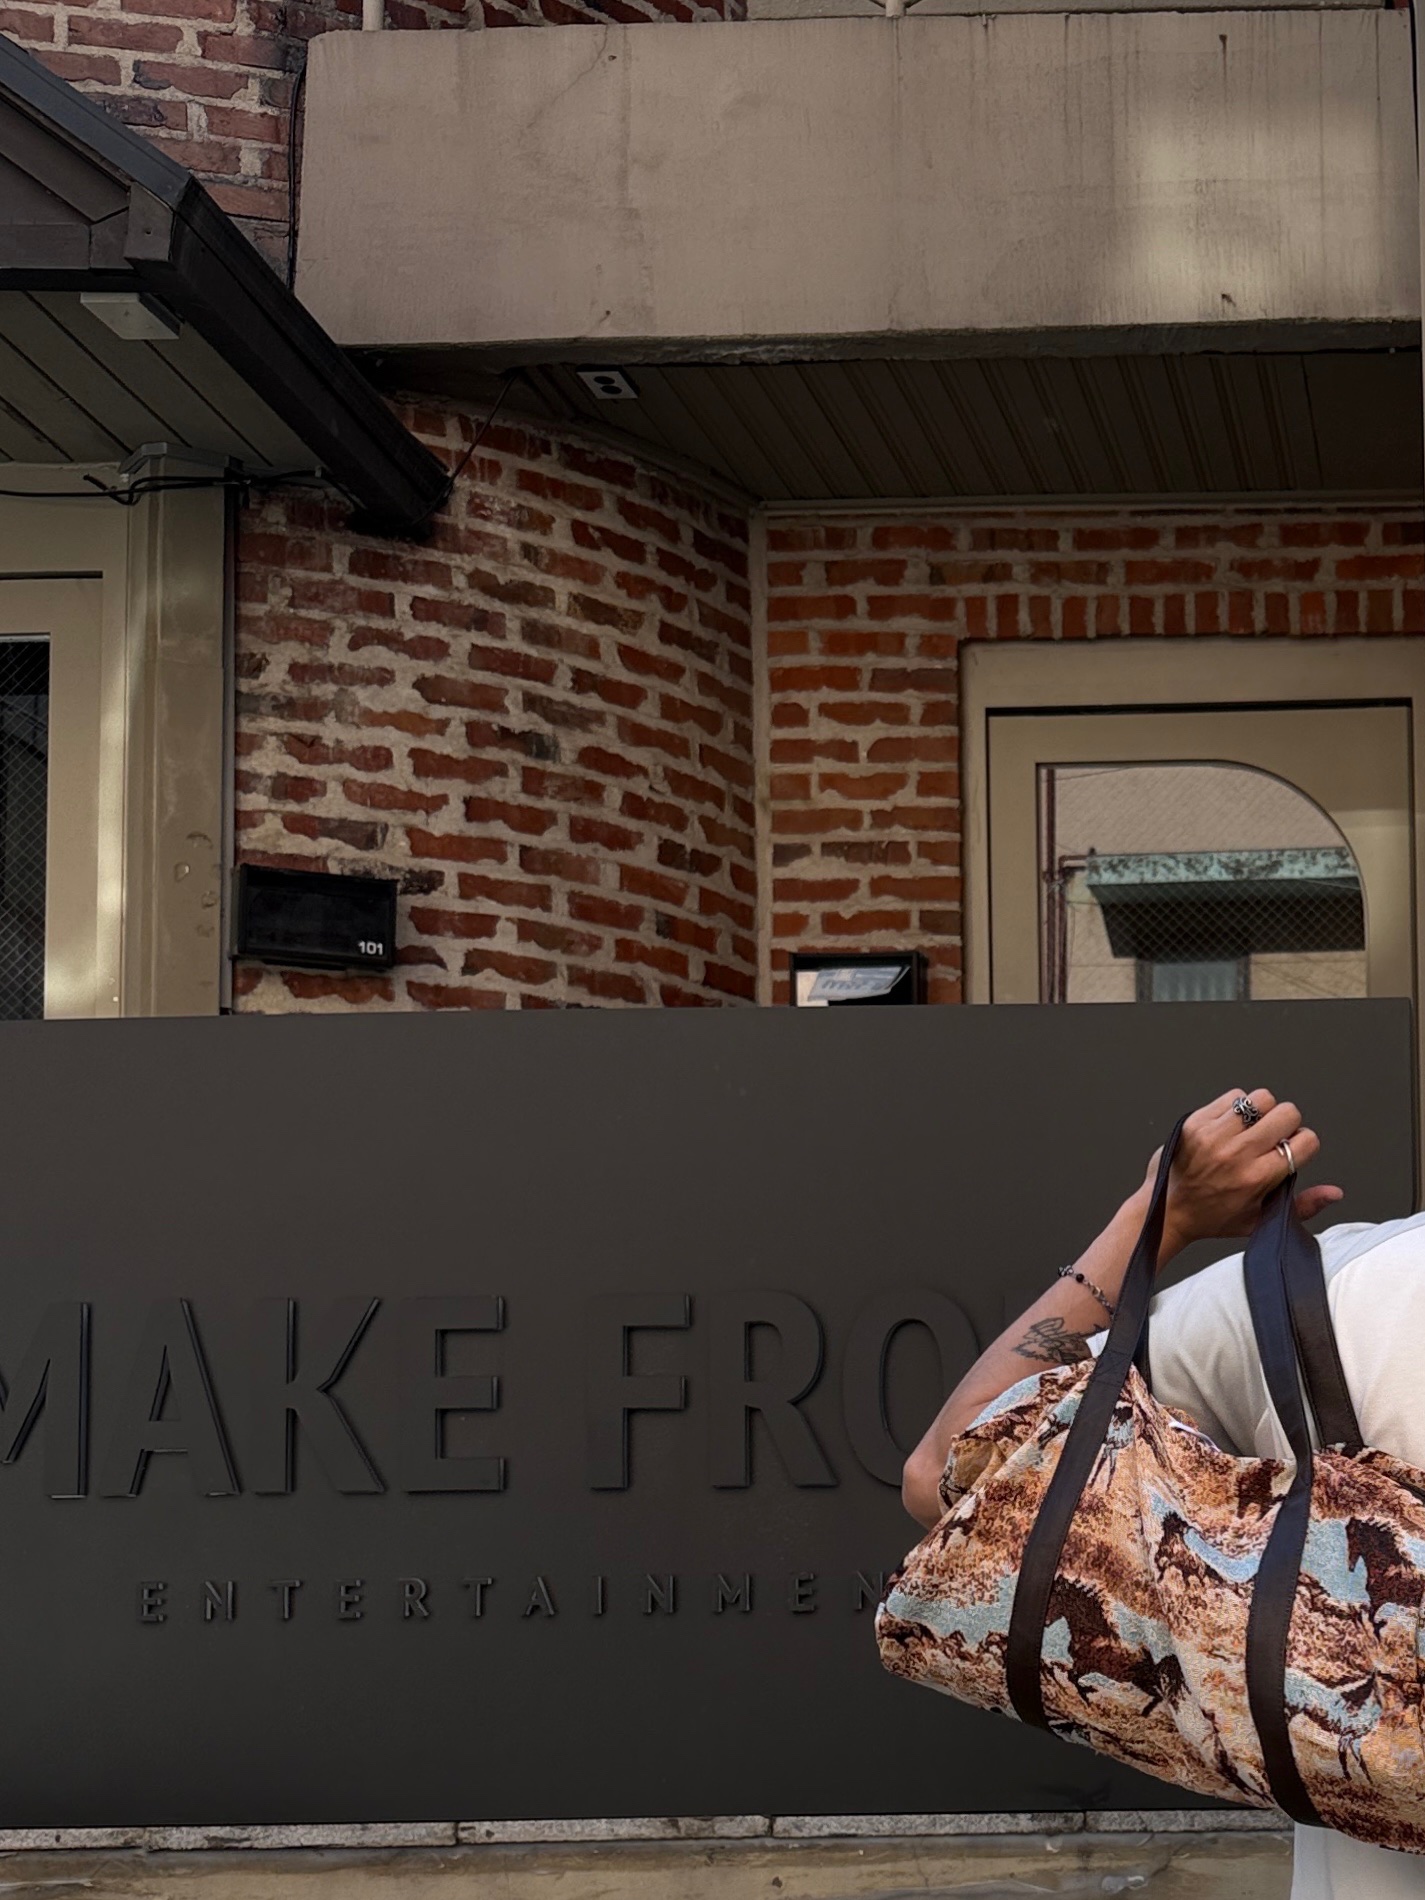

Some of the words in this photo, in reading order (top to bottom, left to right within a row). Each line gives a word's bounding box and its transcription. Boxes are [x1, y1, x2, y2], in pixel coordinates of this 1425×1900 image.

[357, 940, 384, 956] 101
[587, 1287, 985, 1492] FRO
[138, 1570, 888, 1624] ENTERTAINMEN
